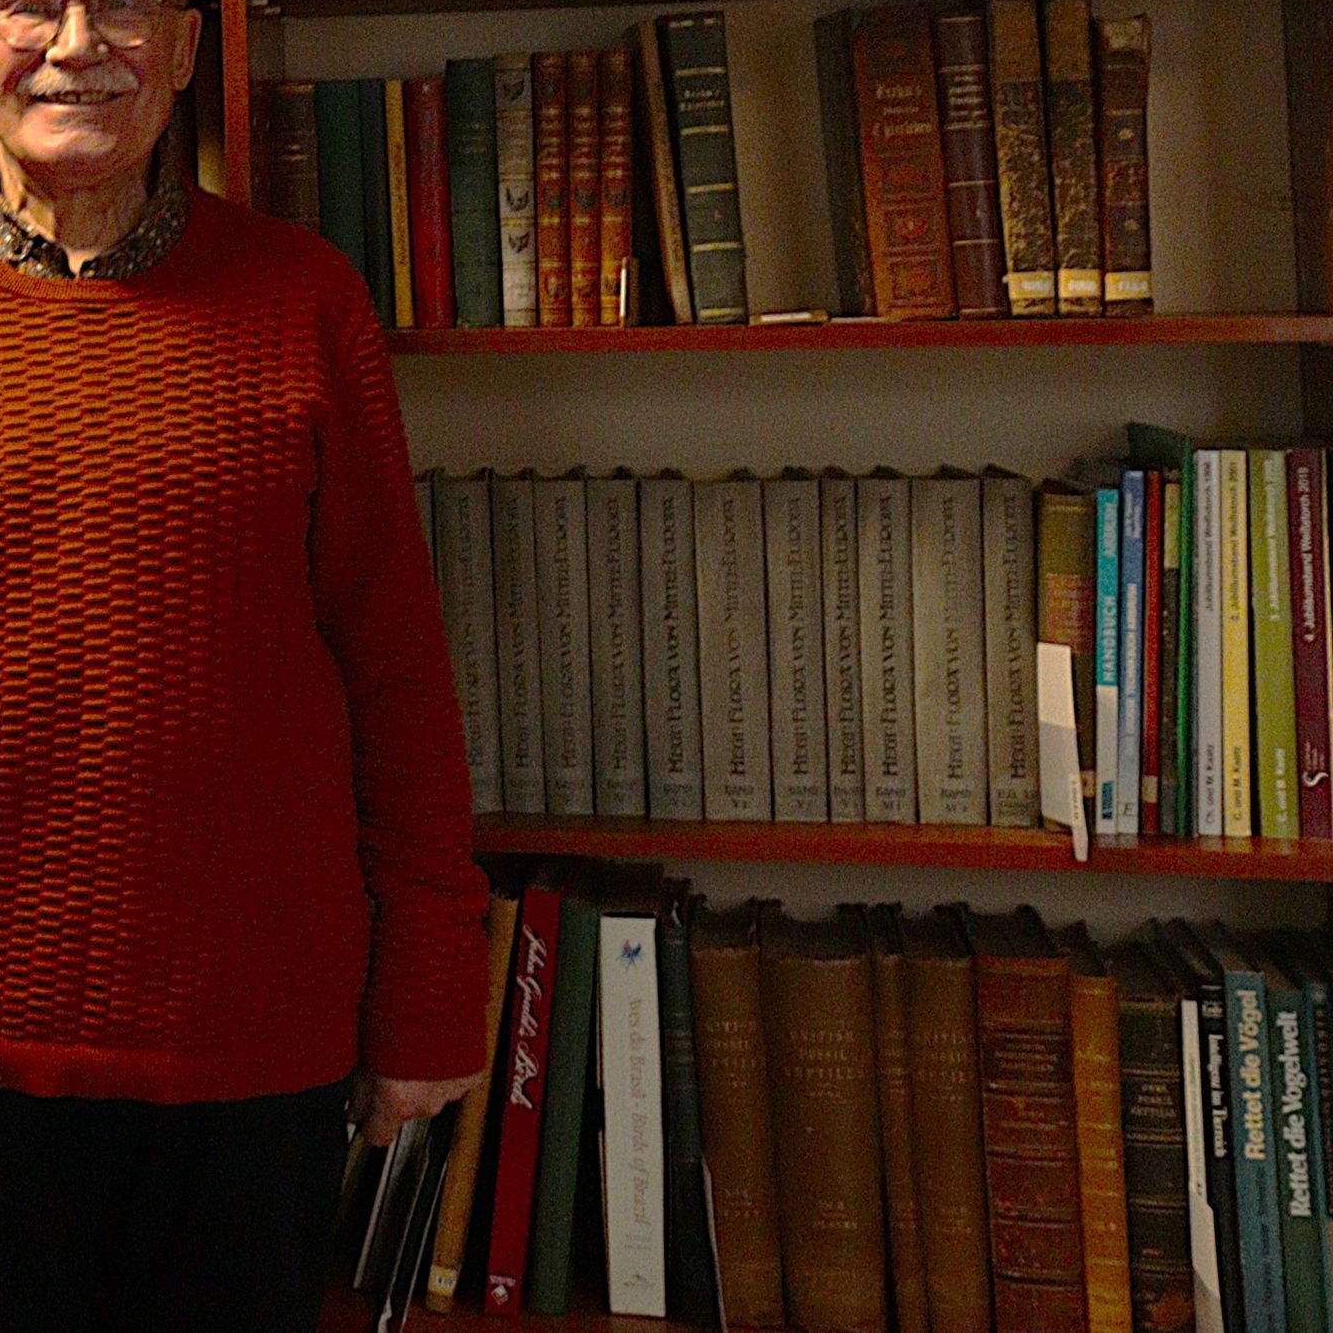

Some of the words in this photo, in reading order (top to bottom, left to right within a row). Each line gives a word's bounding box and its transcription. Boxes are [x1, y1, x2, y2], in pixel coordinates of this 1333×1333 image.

[1101, 595, 1116, 682] HANDBUCH
[1235, 989, 1263, 1051] Vögel
[1240, 1054, 1262, 1087] die
[1275, 1011, 1307, 1112] Vogelwelt
[1243, 1090, 1266, 1160] Rettet
[1282, 1114, 1306, 1149] die
[1286, 1152, 1312, 1217] Rettet
